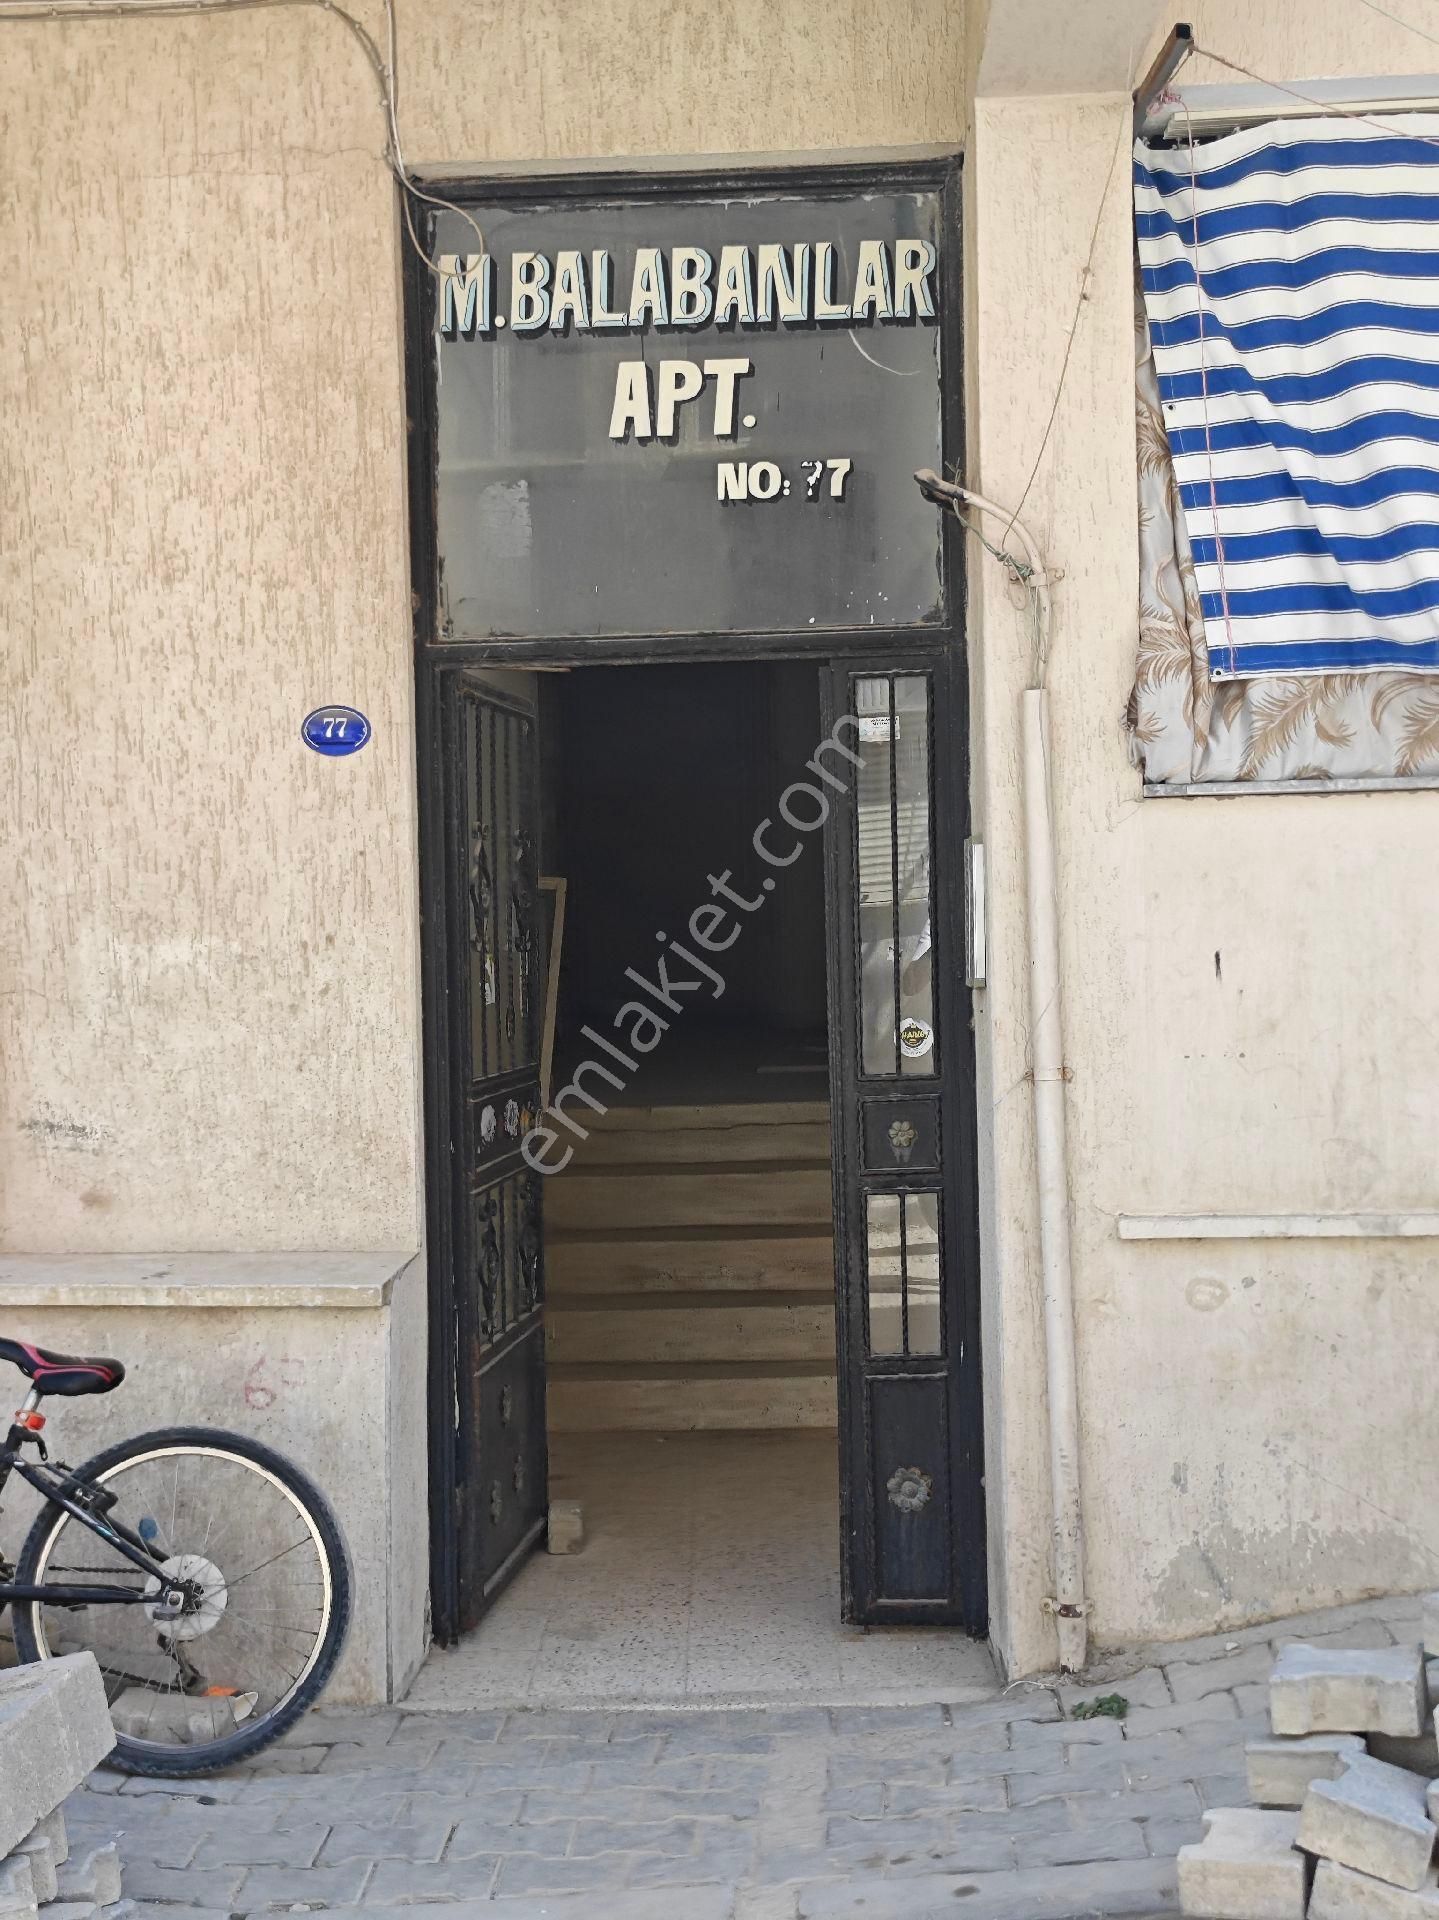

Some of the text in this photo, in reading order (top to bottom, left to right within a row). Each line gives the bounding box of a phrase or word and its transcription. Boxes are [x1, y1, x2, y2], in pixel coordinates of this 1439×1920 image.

[437, 239, 937, 332] M.BALABANLAR
[608, 357, 757, 438] APT.
[717, 461, 791, 500] NO:
[323, 717, 348, 738] 77
